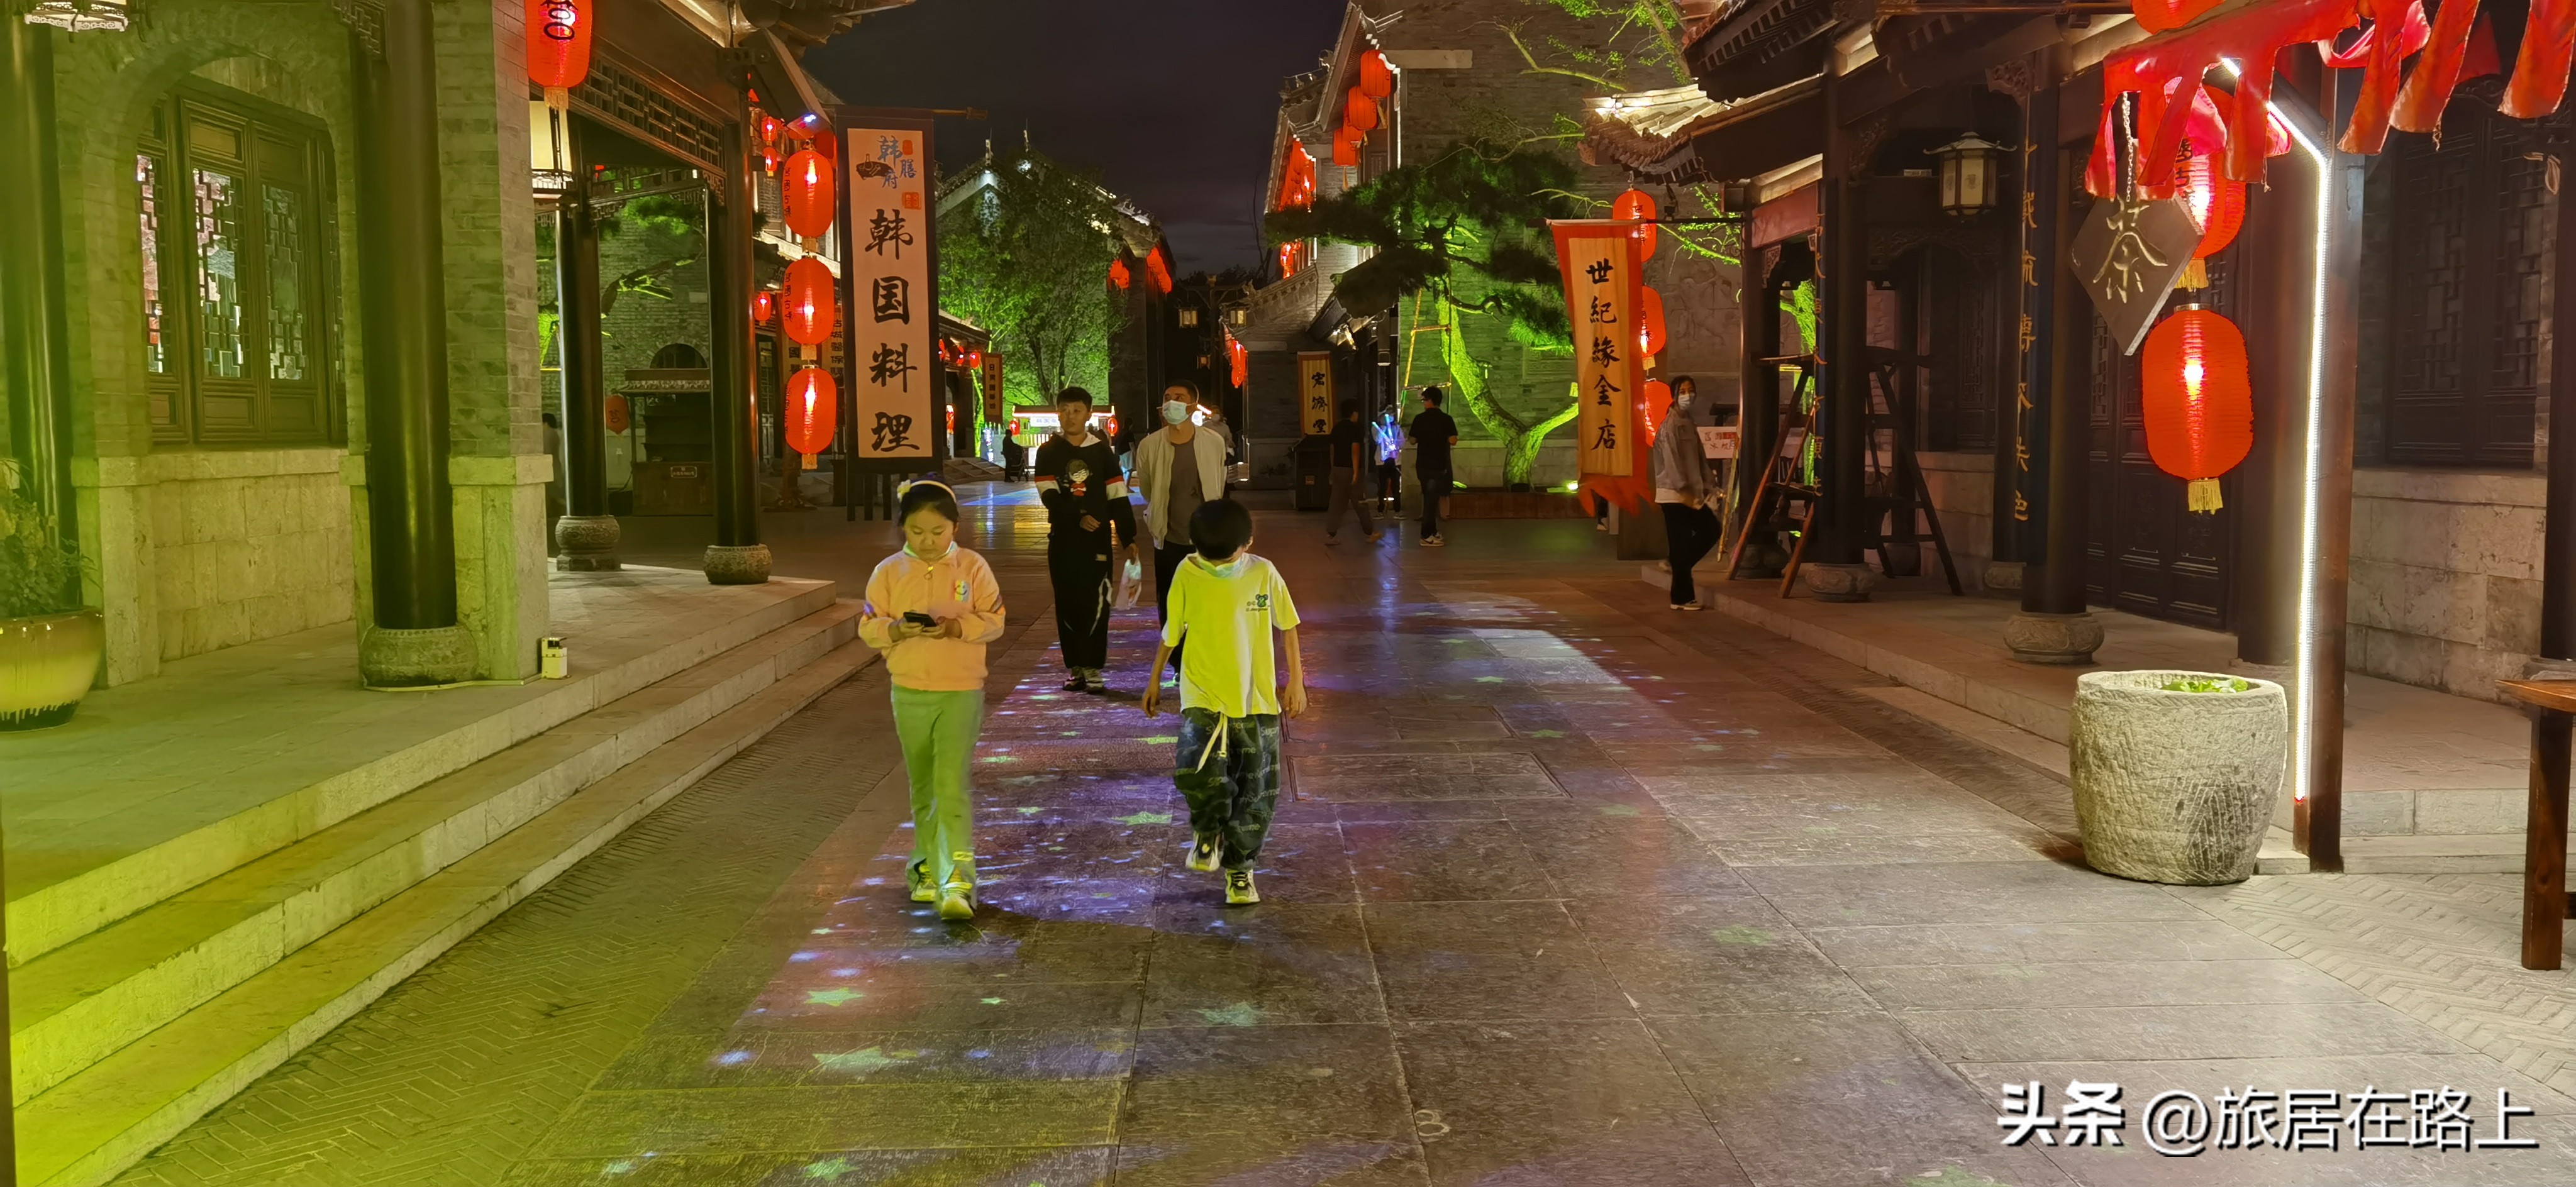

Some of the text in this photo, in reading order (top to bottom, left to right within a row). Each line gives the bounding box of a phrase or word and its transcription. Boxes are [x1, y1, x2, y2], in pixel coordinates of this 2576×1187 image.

[865, 208, 921, 451] 韩国料理
[2092, 194, 2169, 304] 茶
